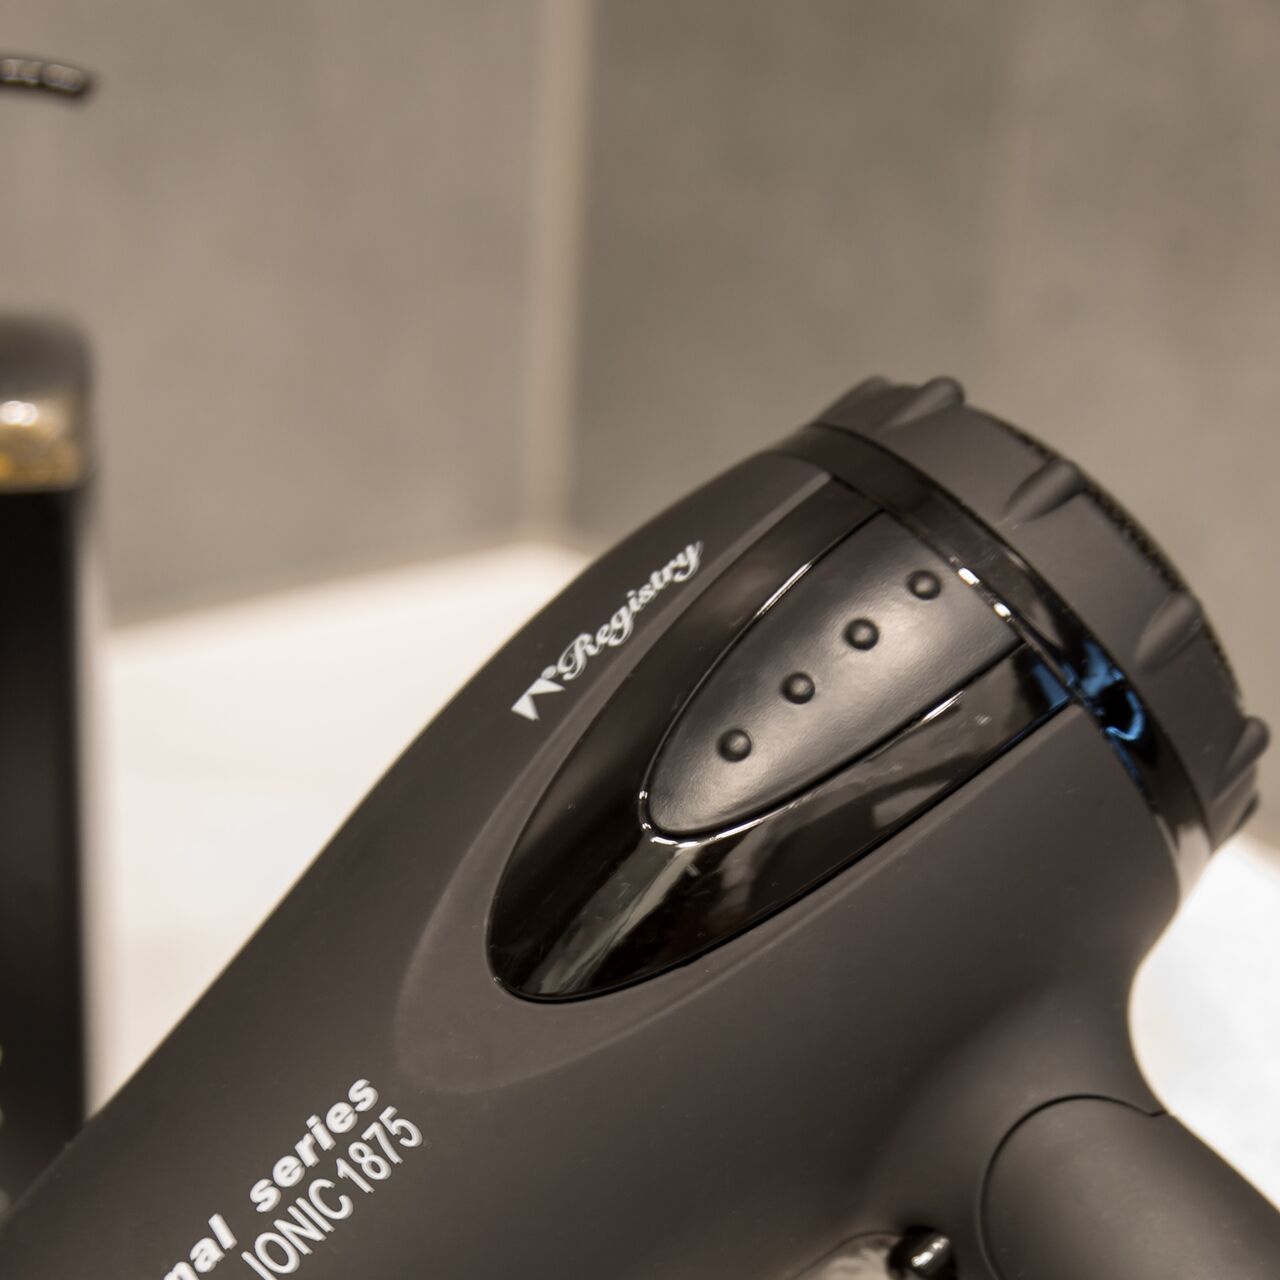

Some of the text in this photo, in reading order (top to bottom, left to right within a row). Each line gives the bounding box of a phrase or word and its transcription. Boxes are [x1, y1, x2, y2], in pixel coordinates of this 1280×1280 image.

[557, 541, 704, 681] Registry
[249, 1078, 379, 1213] series
[335, 1105, 423, 1194] 1875
